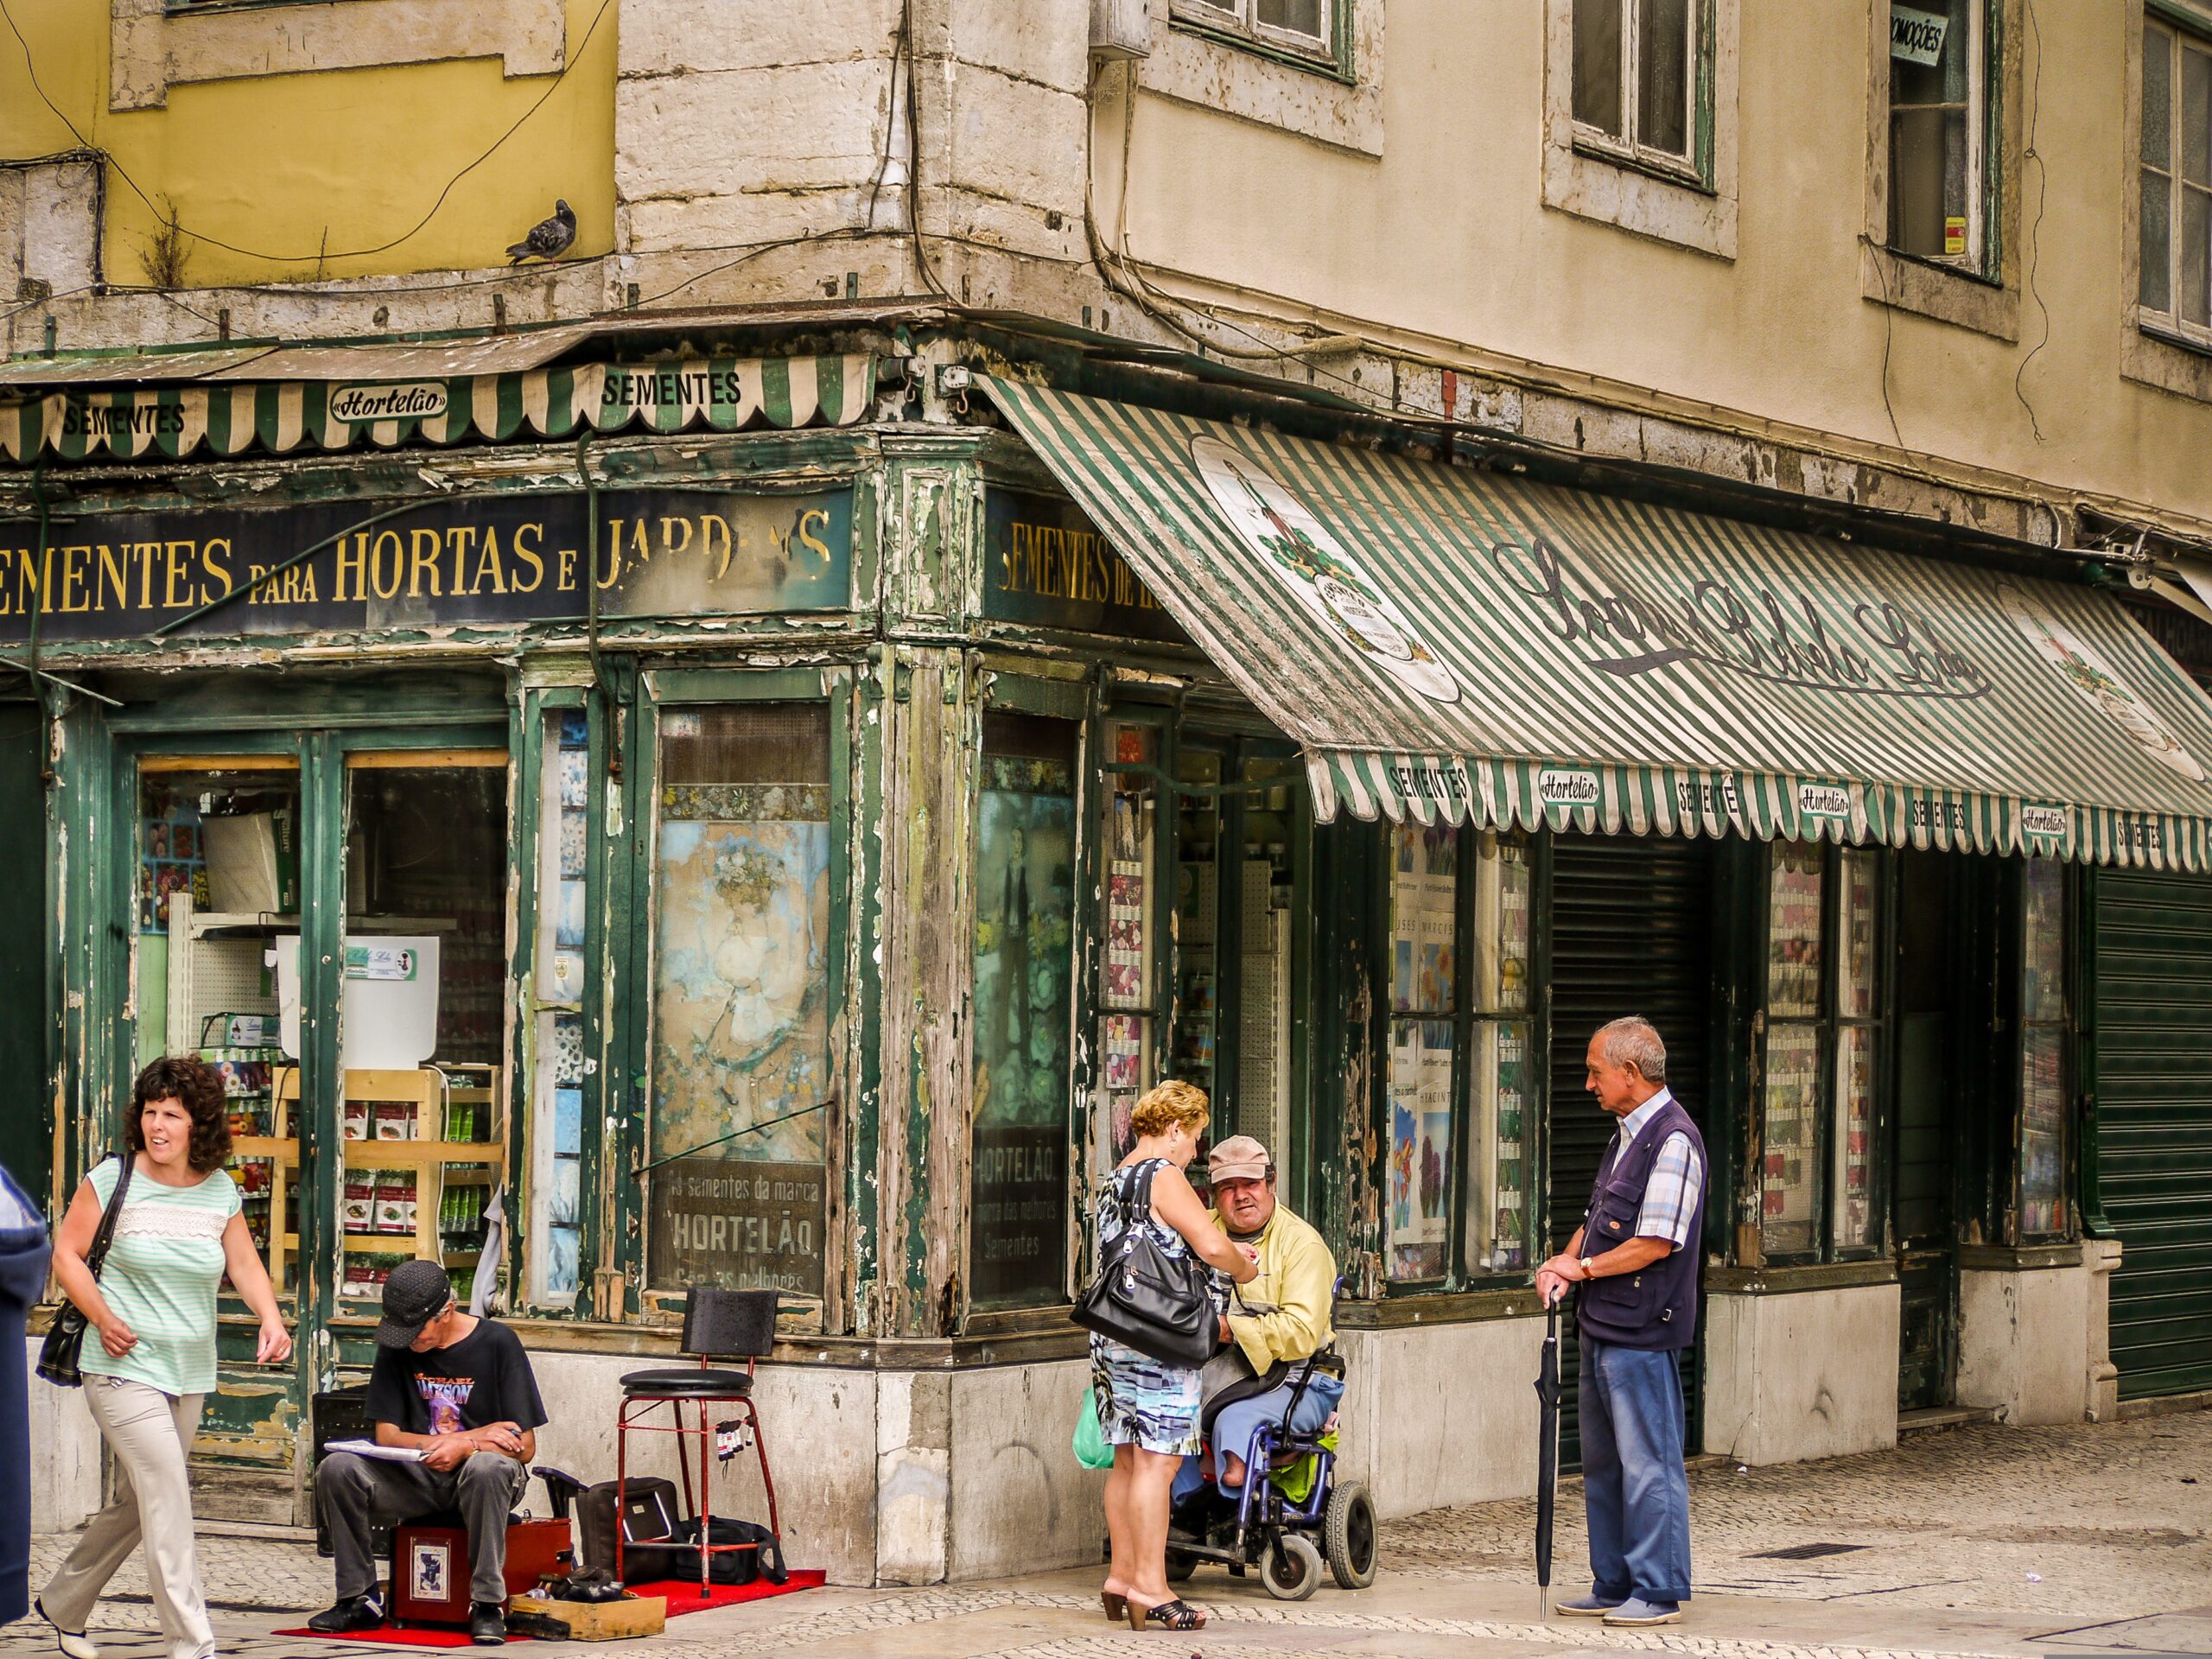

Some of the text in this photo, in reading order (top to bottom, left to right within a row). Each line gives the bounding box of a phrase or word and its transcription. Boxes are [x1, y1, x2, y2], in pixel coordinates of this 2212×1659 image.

[601, 372, 741, 406] SEMENTES
[63, 403, 186, 435] SEMENTES
[248, 563, 318, 605] PARA
[333, 523, 544, 601] HORTAS
[557, 550, 577, 592] E
[1389, 766, 1467, 799] SEMENTES
[1913, 799, 1965, 830] SEMENTES
[688, 1174, 750, 1200] sementes
[754, 1174, 770, 1201] da
[774, 1181, 819, 1203] marca
